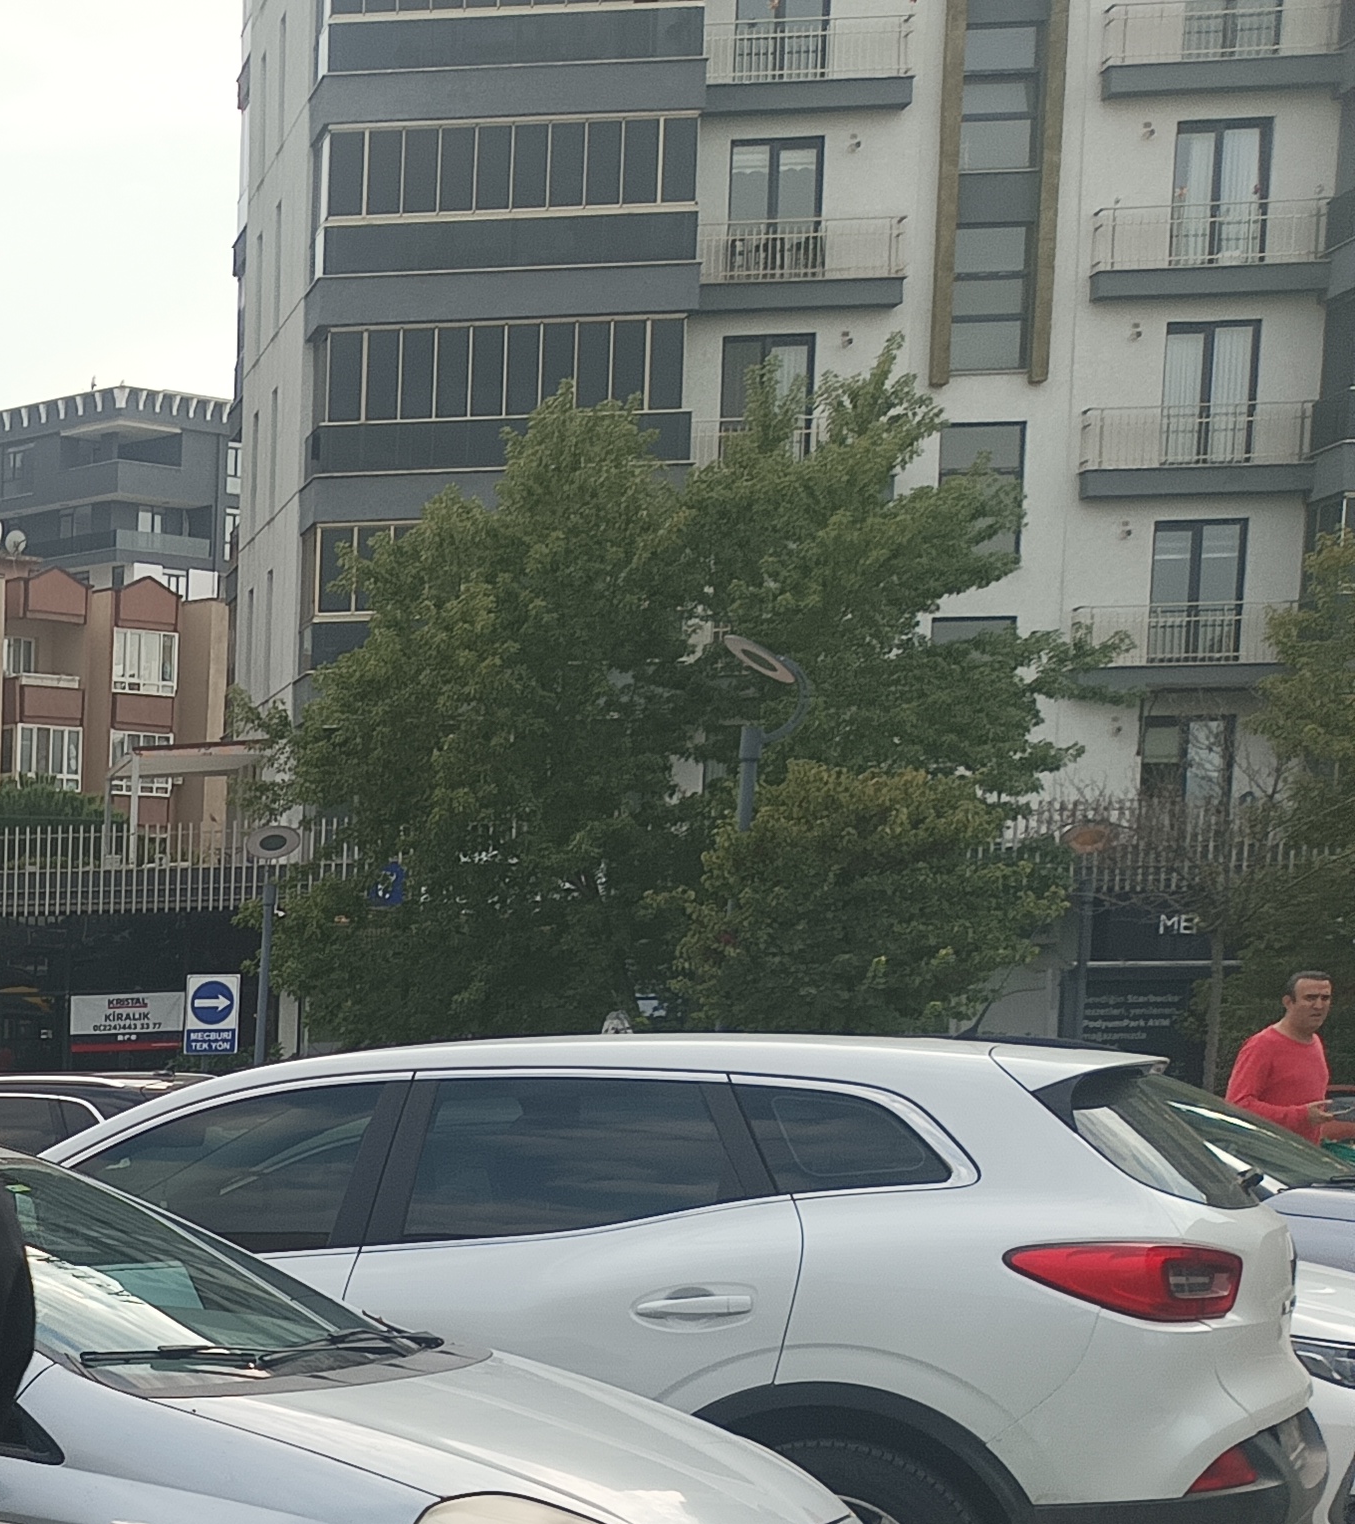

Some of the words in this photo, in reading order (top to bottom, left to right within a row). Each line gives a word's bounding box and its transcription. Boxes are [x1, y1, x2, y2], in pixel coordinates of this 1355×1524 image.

[104, 1011, 151, 1022] KİRALIK
[191, 1042, 209, 1051] TEK
[211, 1041, 230, 1050] YÖN
